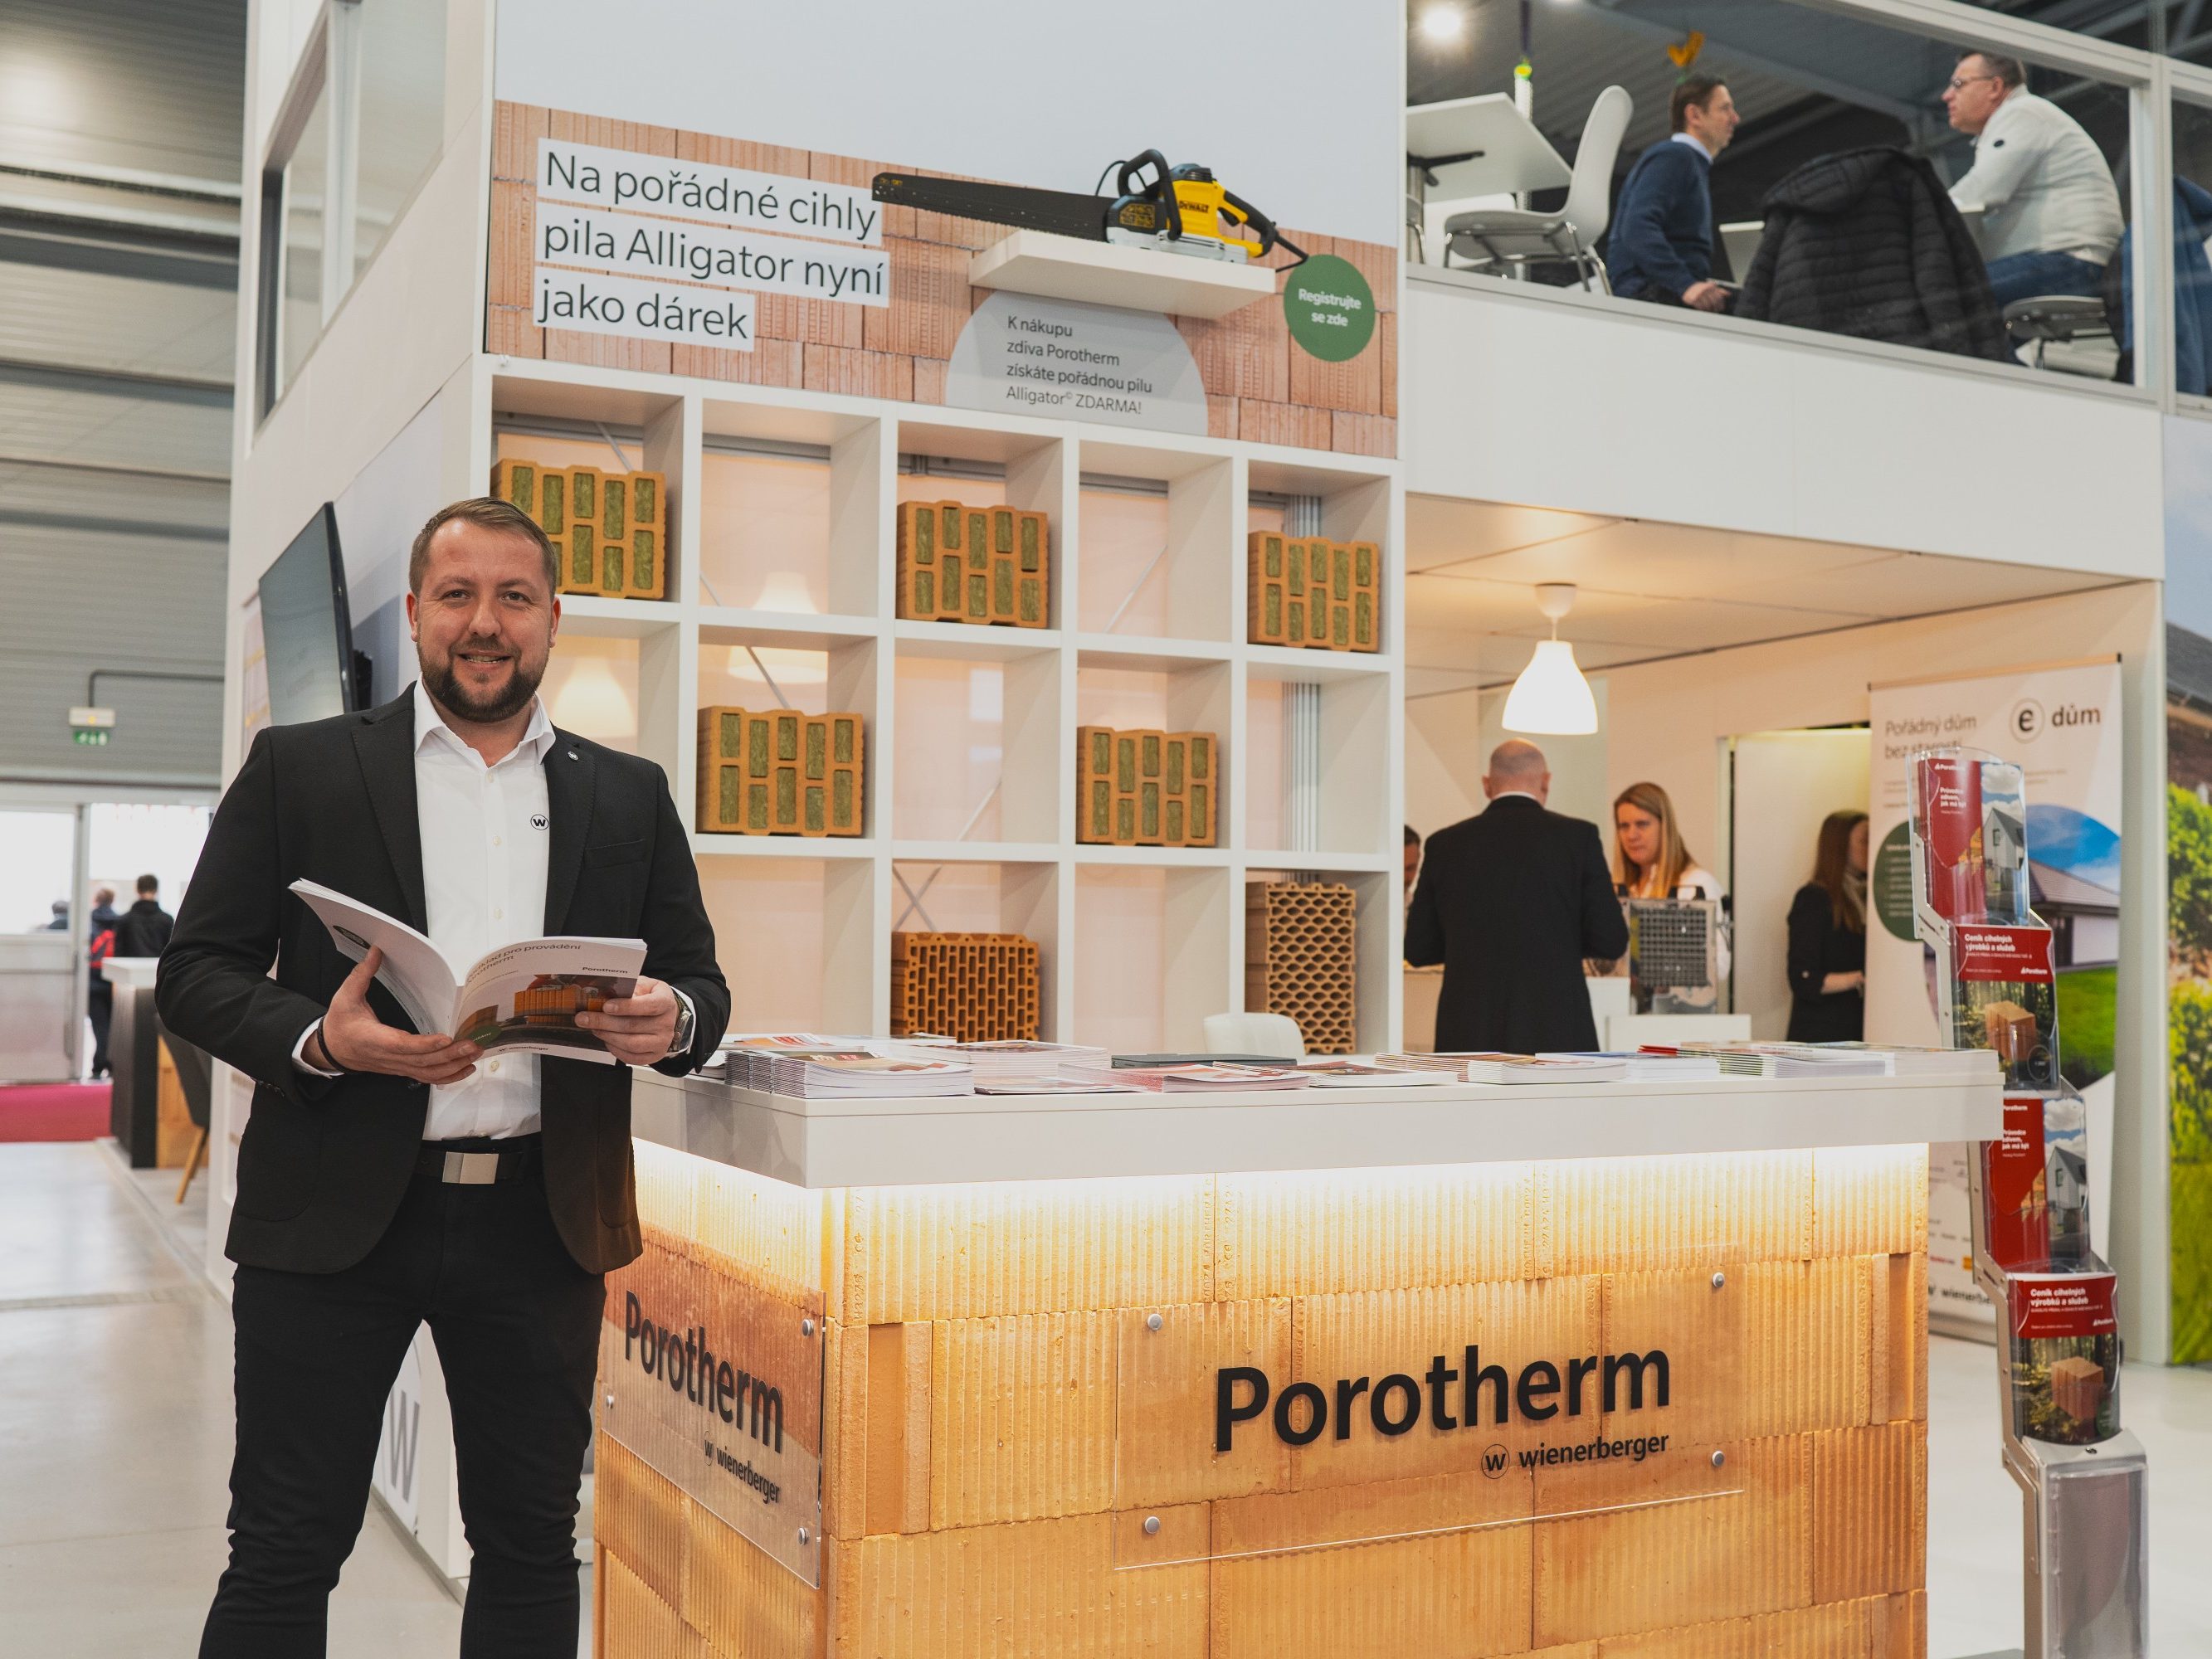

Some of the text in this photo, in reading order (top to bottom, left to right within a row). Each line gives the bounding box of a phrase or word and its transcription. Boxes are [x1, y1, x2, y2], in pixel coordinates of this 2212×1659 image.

[547, 151, 876, 241] Na pořádné cihly
[544, 218, 884, 298] pila Alligator nyní
[537, 278, 748, 339] jako dárek
[1298, 287, 1362, 312] Registrujte
[1007, 315, 1073, 338] K nákupu
[1311, 310, 1348, 328] se zde
[1006, 339, 1120, 367] zdiva Porotherm
[1006, 363, 1153, 394] získáte pořádnou pilu
[1075, 393, 1143, 416] ZDARMA!
[1885, 713, 1977, 737] Pořádný dům
[2051, 704, 2102, 728] dům
[504, 947, 522, 959] pro
[524, 942, 582, 954] provádění
[582, 966, 629, 975] Porotherm
[626, 1290, 784, 1455] Porotherm
[1216, 1345, 1670, 1452] Porotherm
[1518, 1433, 1669, 1469] wienerberger
[716, 1446, 782, 1505] wienerberger
